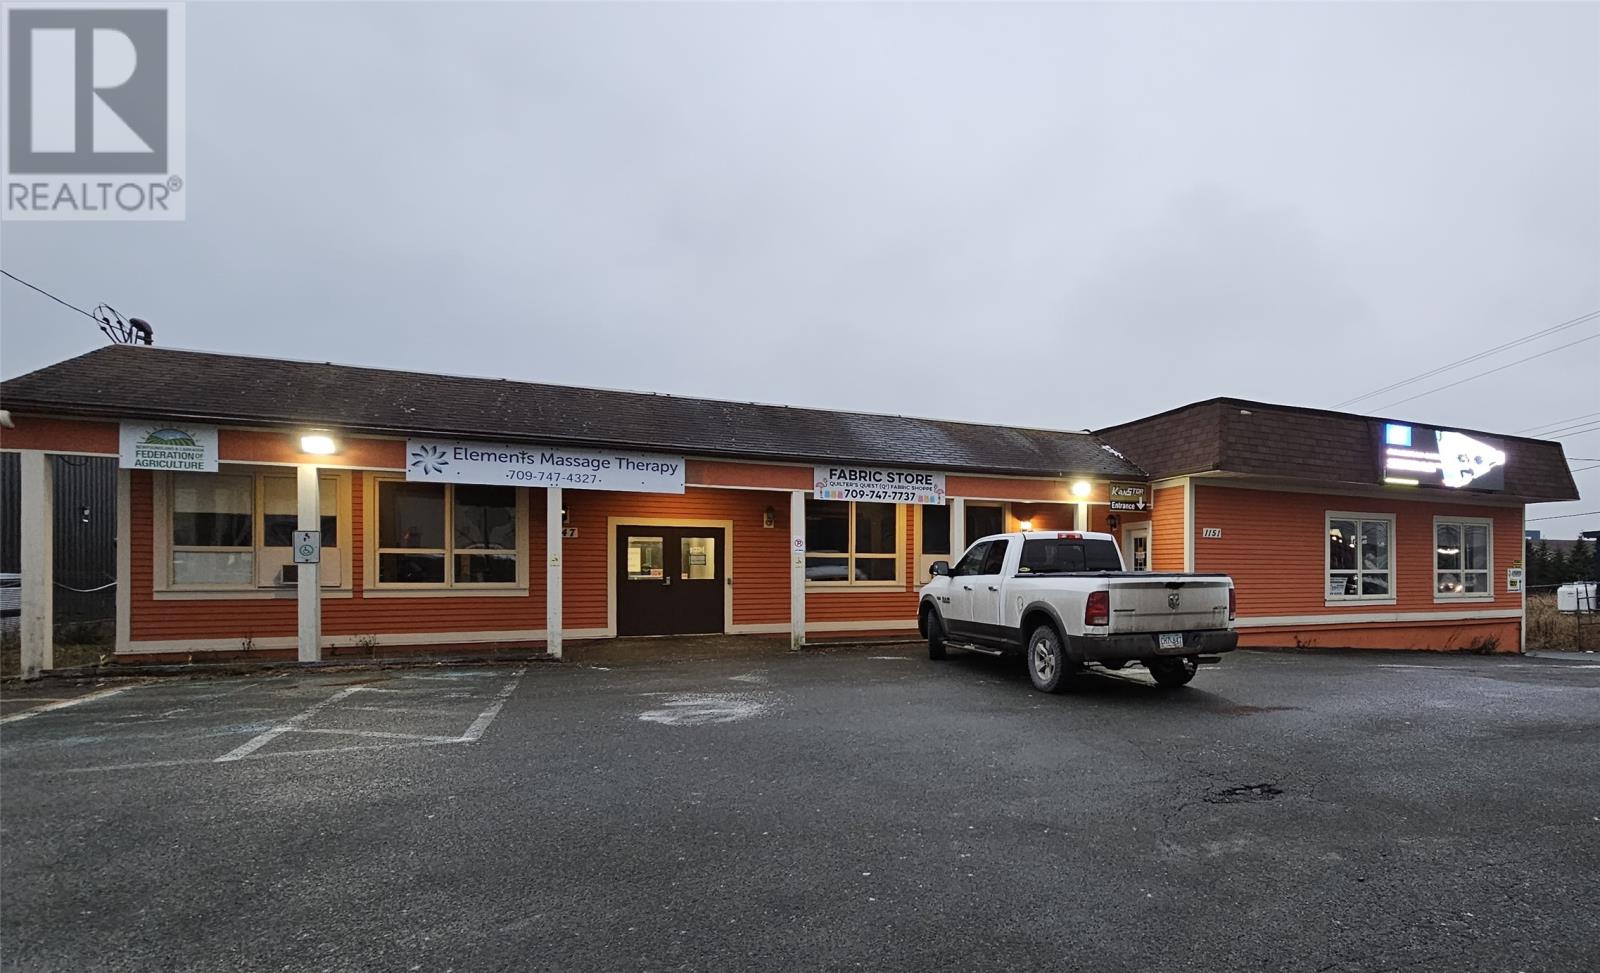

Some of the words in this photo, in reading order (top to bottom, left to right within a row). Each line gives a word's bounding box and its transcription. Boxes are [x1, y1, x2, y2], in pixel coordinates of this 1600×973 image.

[136, 450, 194, 460] FEDERATION
[135, 459, 205, 469] AGRICULTURE
[453, 447, 535, 465] Elements
[540, 452, 611, 472] Massage
[615, 457, 679, 476] Therapy
[508, 470, 597, 484] 709-747-4327
[829, 468, 883, 482] FABRIC
[887, 471, 933, 485] STORE
[844, 489, 916, 501] 709-747-7737
[1111, 501, 1136, 510] Entrance
[1204, 529, 1220, 537] 1151
